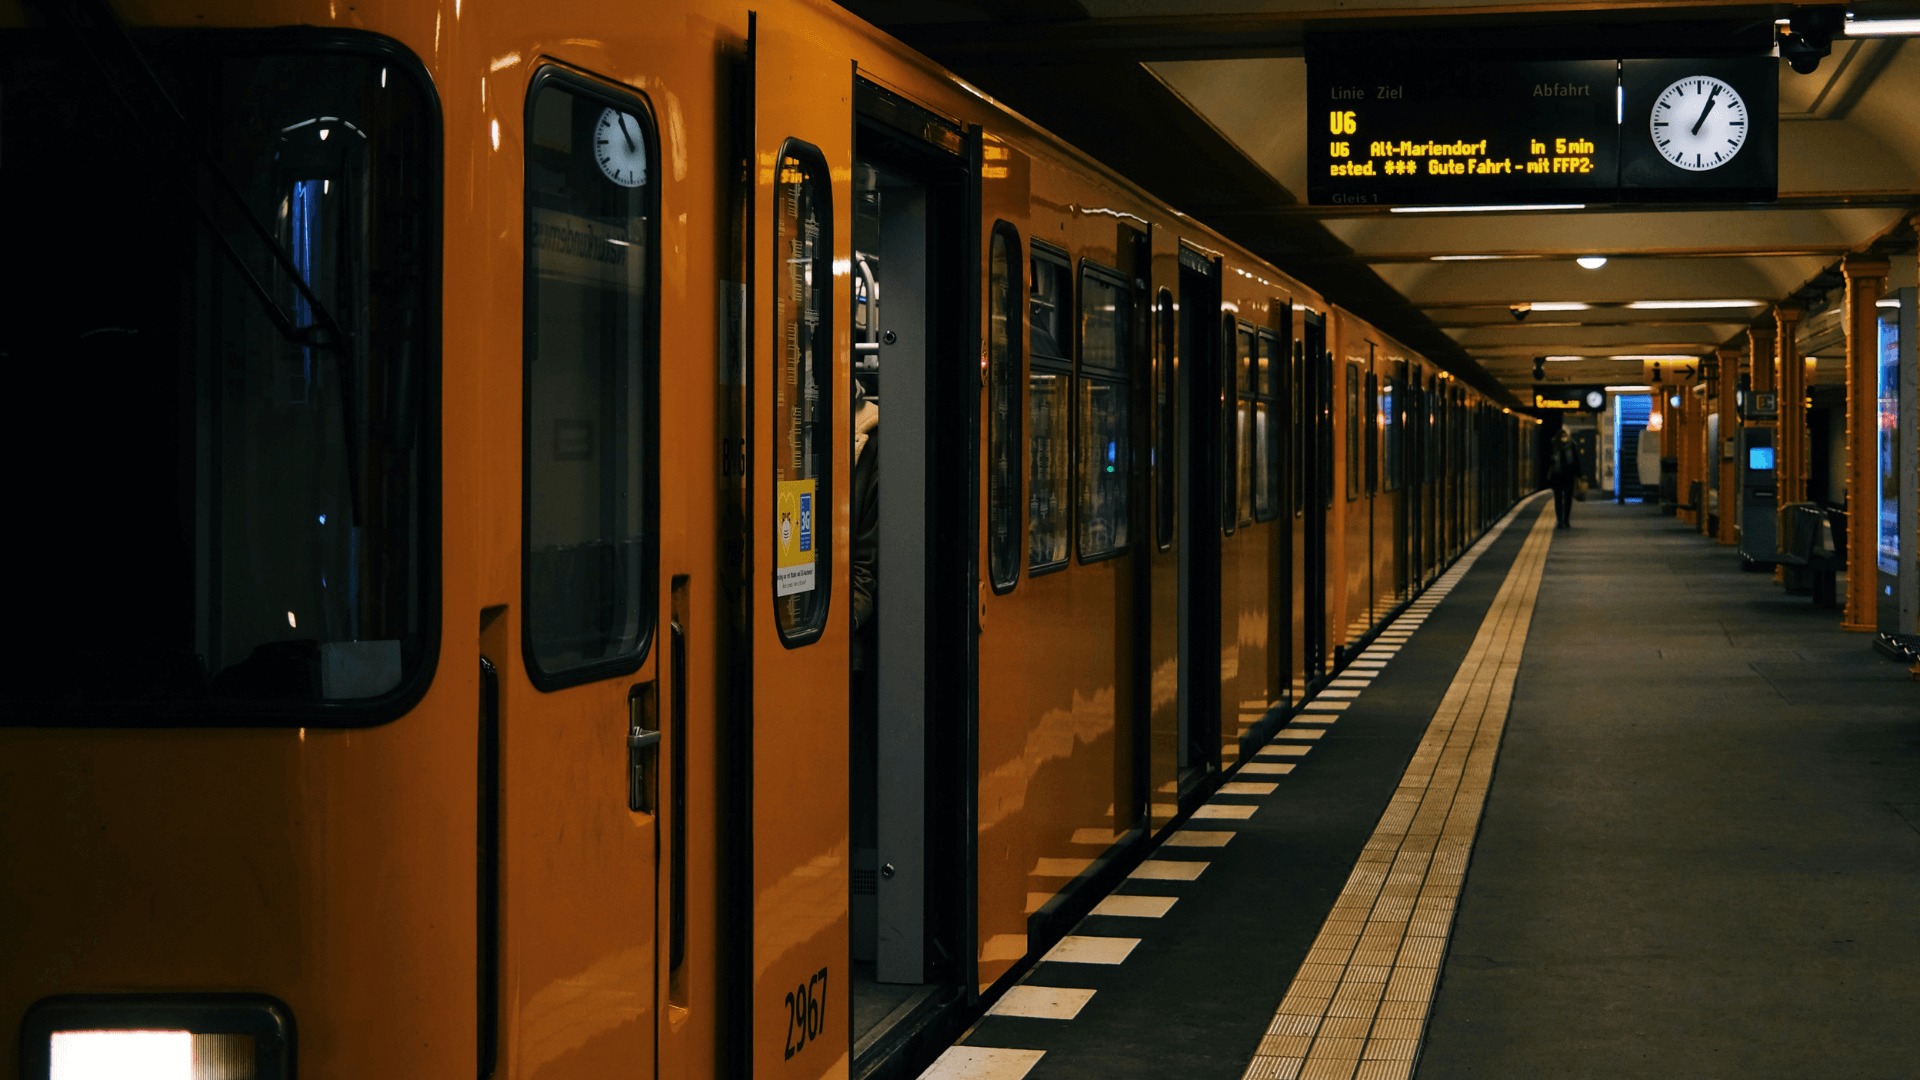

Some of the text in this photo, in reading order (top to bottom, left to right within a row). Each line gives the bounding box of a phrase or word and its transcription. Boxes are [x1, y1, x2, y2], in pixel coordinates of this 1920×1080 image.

[1330, 85, 1403, 100] Linie Ziel
[1532, 83, 1591, 98] Abfahrt
[1329, 110, 1357, 135] U6
[1329, 137, 1595, 158] U6 Alt-Mariendorf in 5 min
[1329, 160, 1377, 176] ested.
[1428, 159, 1465, 175] Gute
[1467, 157, 1511, 174] Fahrt
[1526, 157, 1550, 173] mit
[1331, 192, 1379, 204] Gleis 1
[784, 966, 827, 1062] 2967
